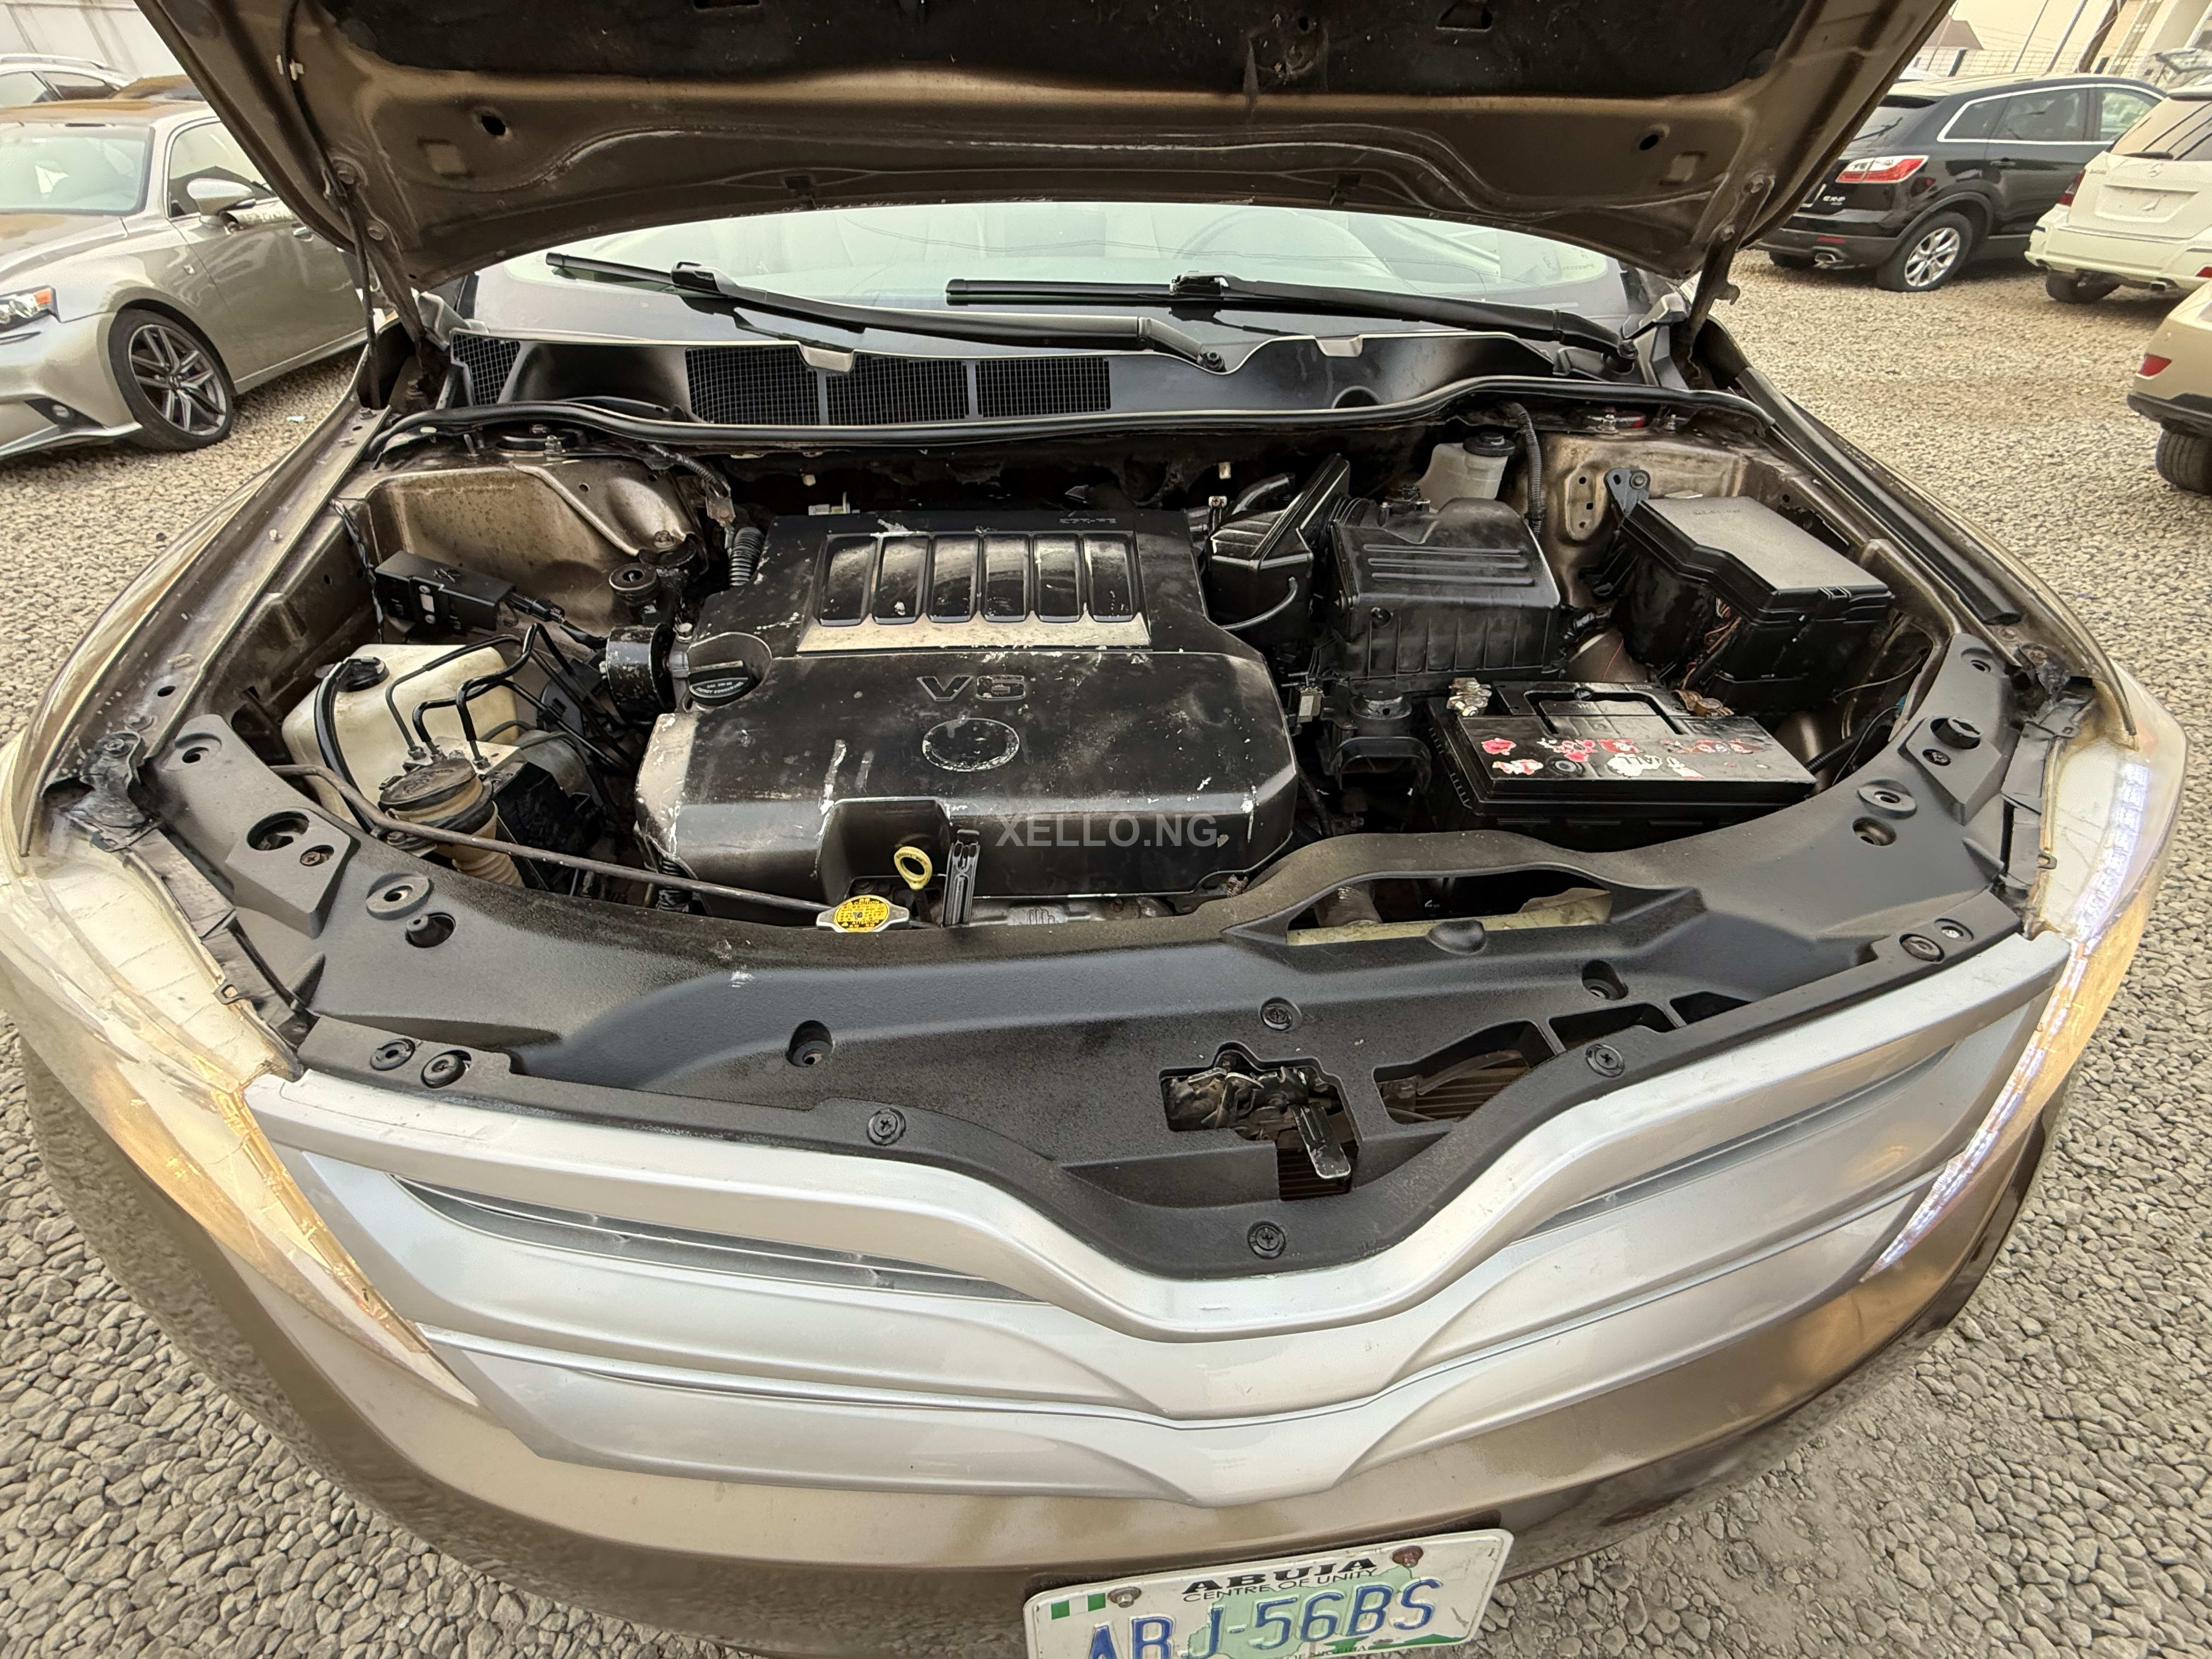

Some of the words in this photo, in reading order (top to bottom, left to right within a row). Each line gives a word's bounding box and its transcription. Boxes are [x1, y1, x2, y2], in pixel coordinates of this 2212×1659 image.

[917, 675, 1026, 701] V6
[1182, 1558, 1377, 1594] ABUJA
[1183, 1583, 1270, 1602] CENTRE
[1278, 1578, 1310, 1589] OF
[1317, 1568, 1378, 1584] UNITY
[1088, 1578, 1444, 1659] ABJ-56BS
